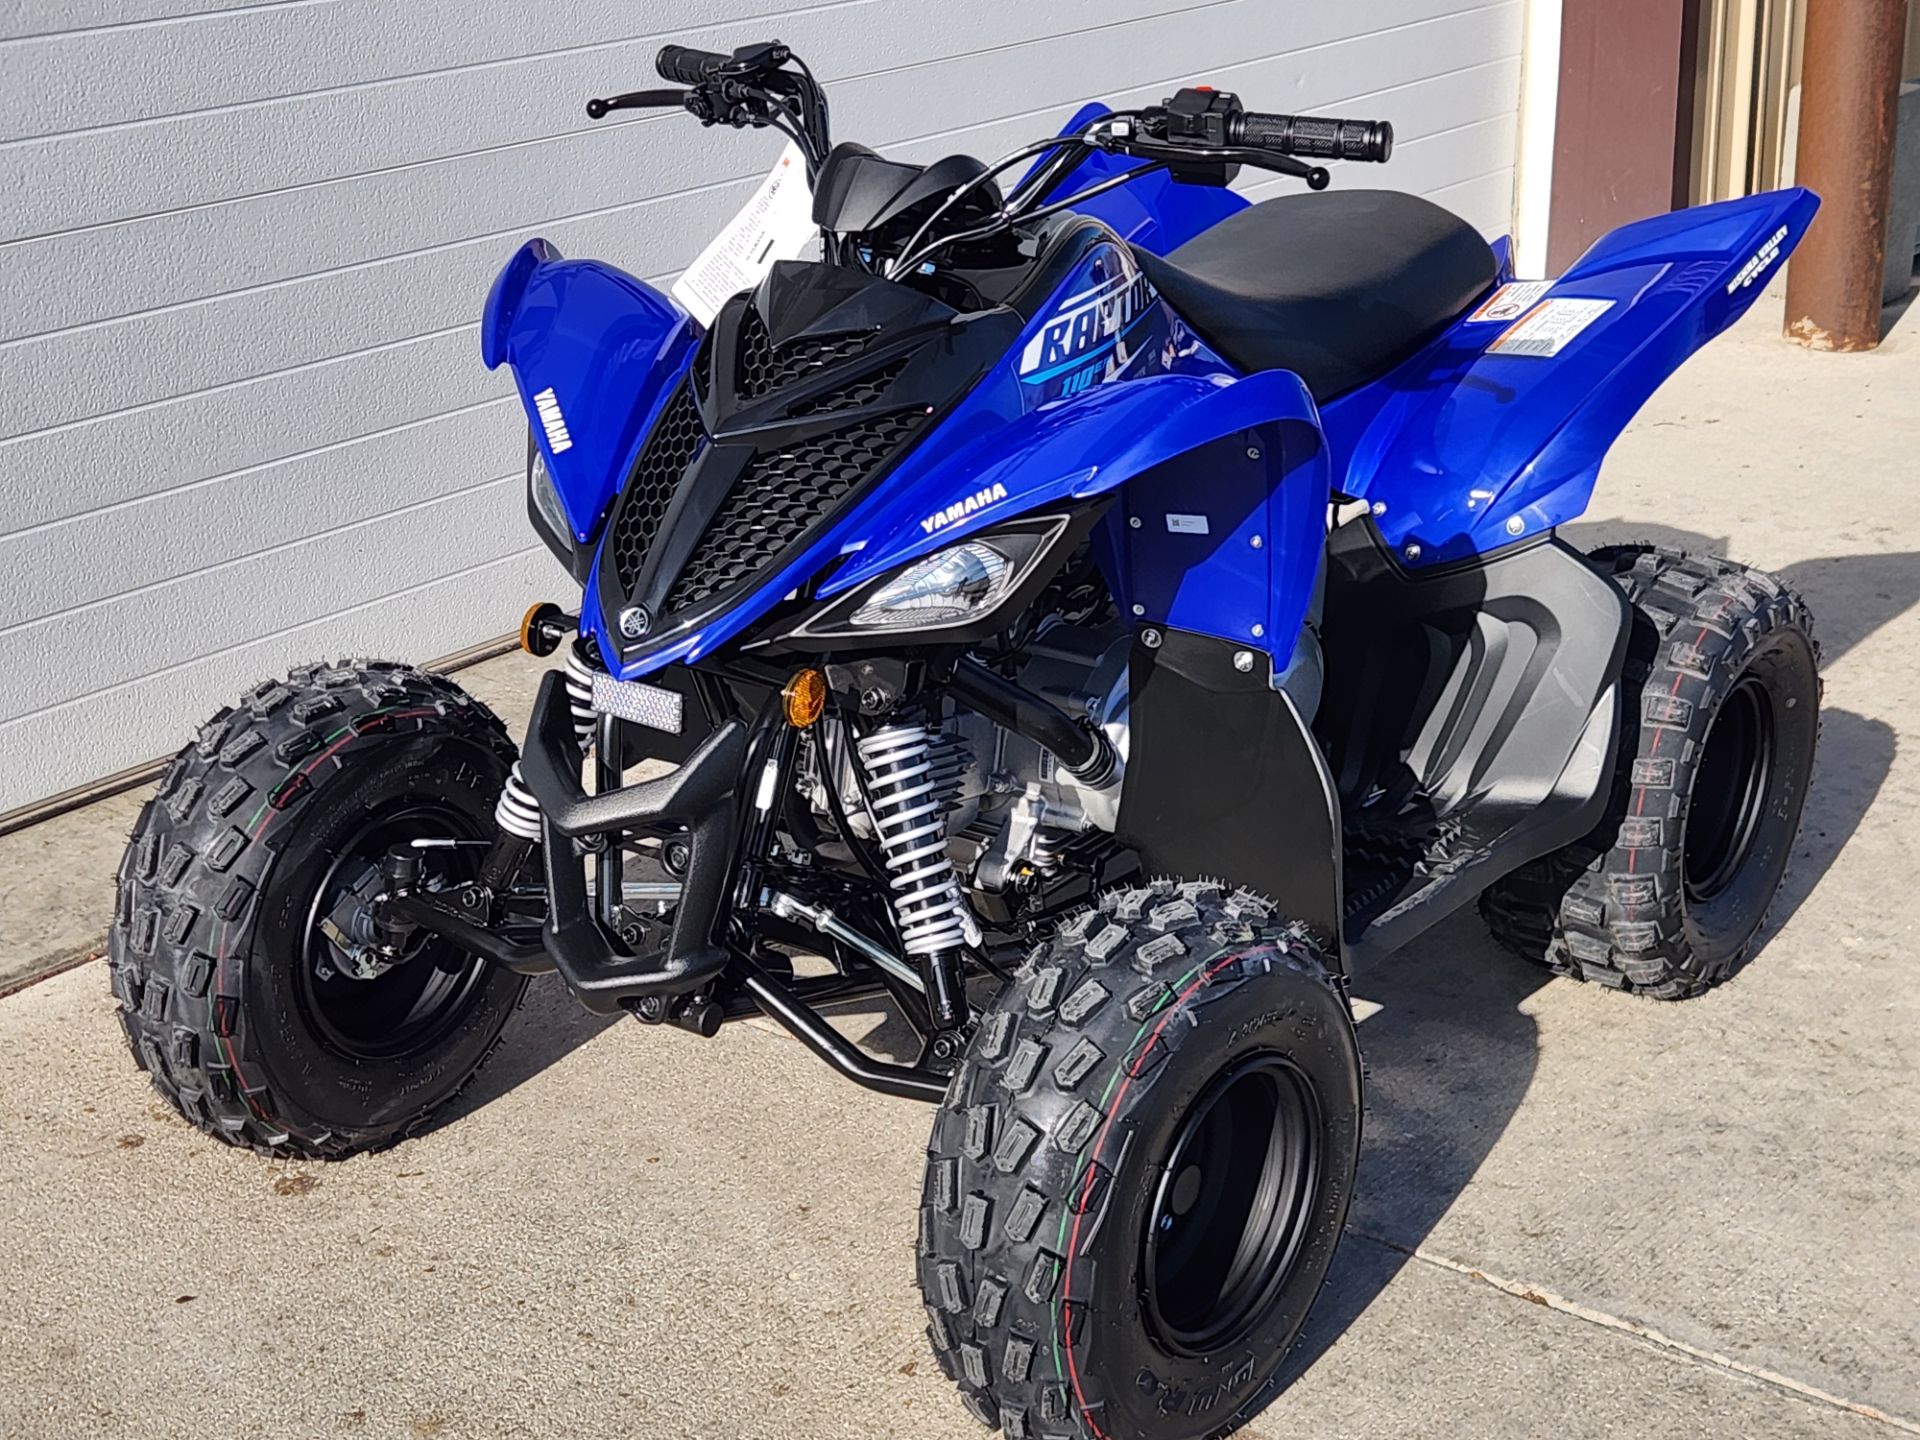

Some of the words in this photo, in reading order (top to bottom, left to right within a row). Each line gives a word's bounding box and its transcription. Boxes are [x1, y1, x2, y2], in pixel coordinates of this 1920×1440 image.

[1742, 246, 1779, 287] CYCLE
[533, 386, 573, 455] YAMAHA
[920, 482, 1008, 534] YAMAHA
